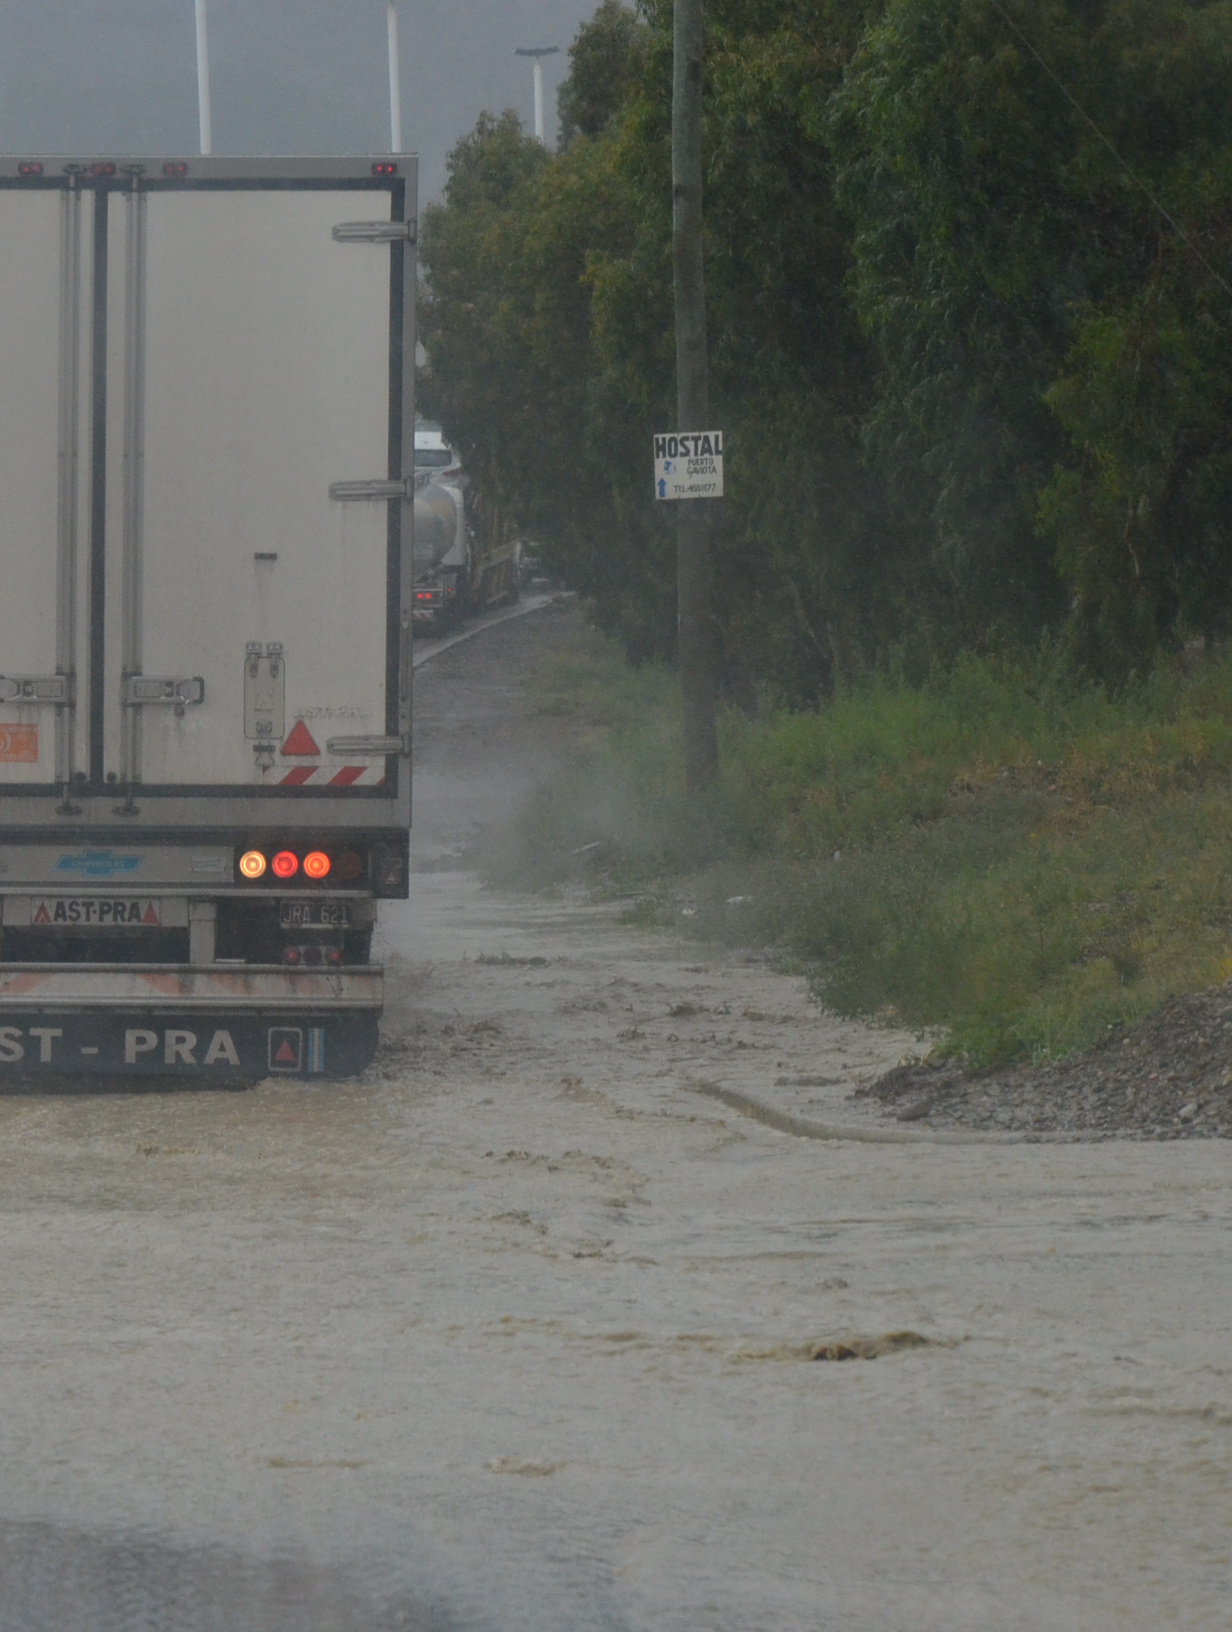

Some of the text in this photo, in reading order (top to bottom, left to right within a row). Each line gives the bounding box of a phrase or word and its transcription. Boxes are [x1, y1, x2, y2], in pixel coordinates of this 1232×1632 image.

[655, 435, 722, 458] HOSTAL
[687, 466, 717, 475] GAVIOTA
[688, 458, 714, 466] PUERTO
[283, 905, 347, 923] JRA 621
[124, 1029, 241, 1066] PRA
